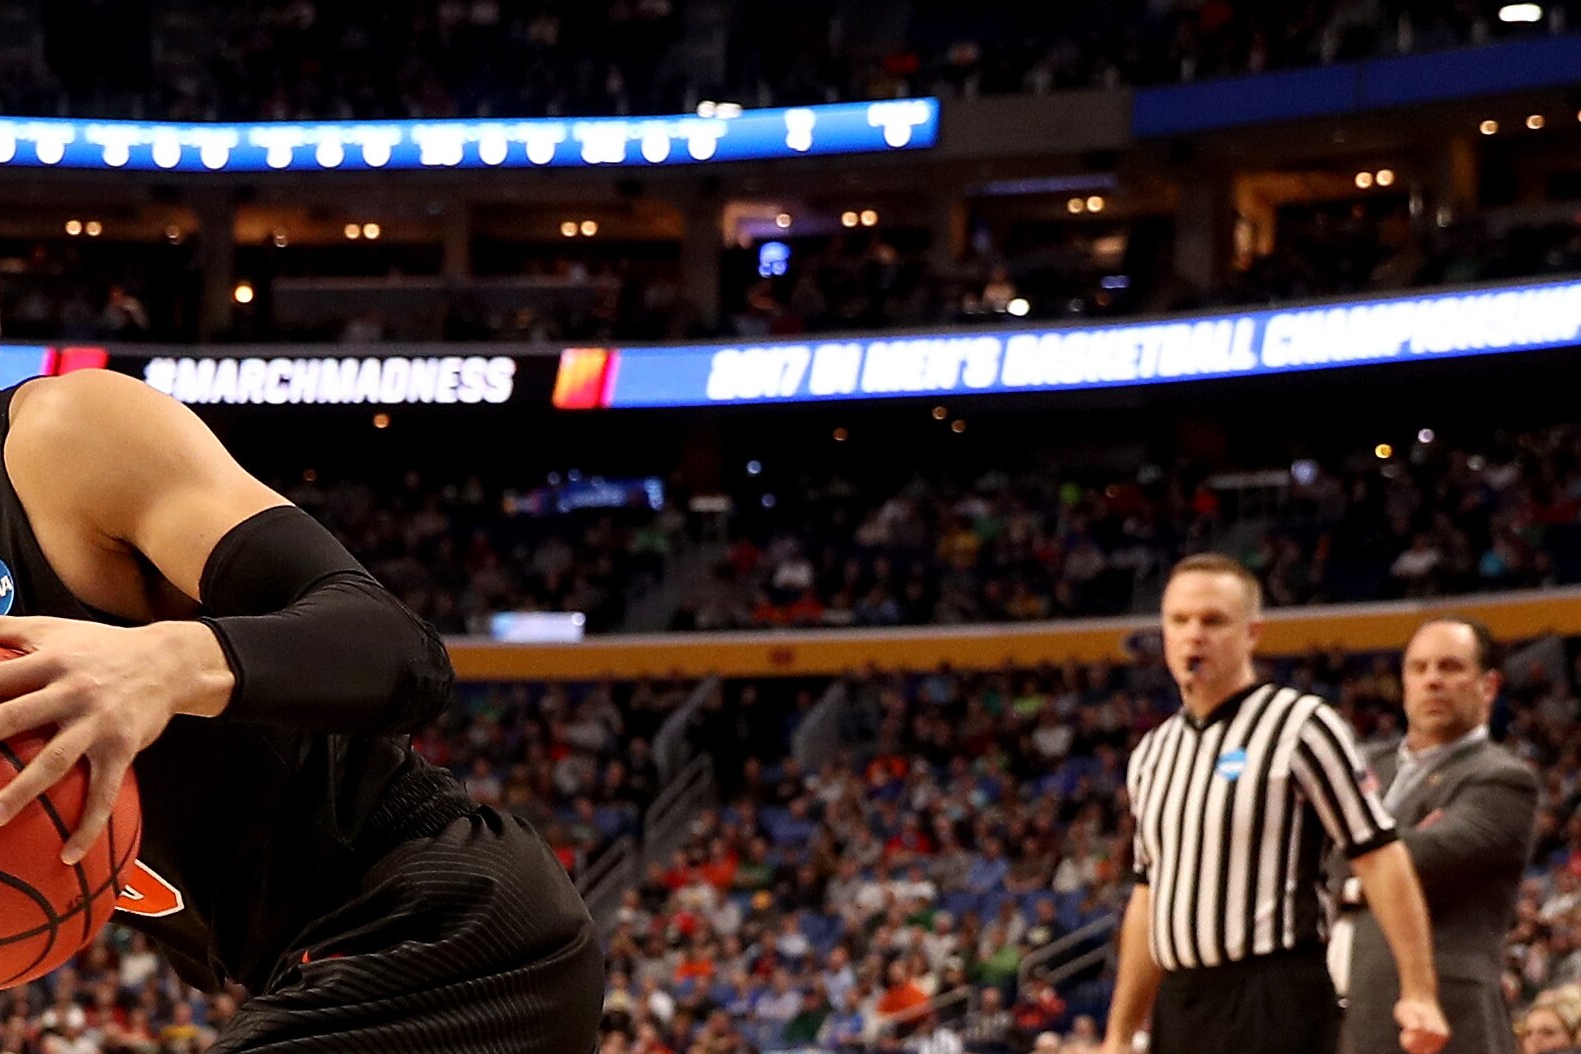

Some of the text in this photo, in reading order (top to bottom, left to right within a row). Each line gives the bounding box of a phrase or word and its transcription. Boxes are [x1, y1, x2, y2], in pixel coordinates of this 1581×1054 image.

[144, 356, 516, 404] #MARCHMADNESS
[706, 345, 811, 400] 2017
[861, 336, 1001, 393] MEN'S
[1001, 316, 1258, 387] BASKETBALL
